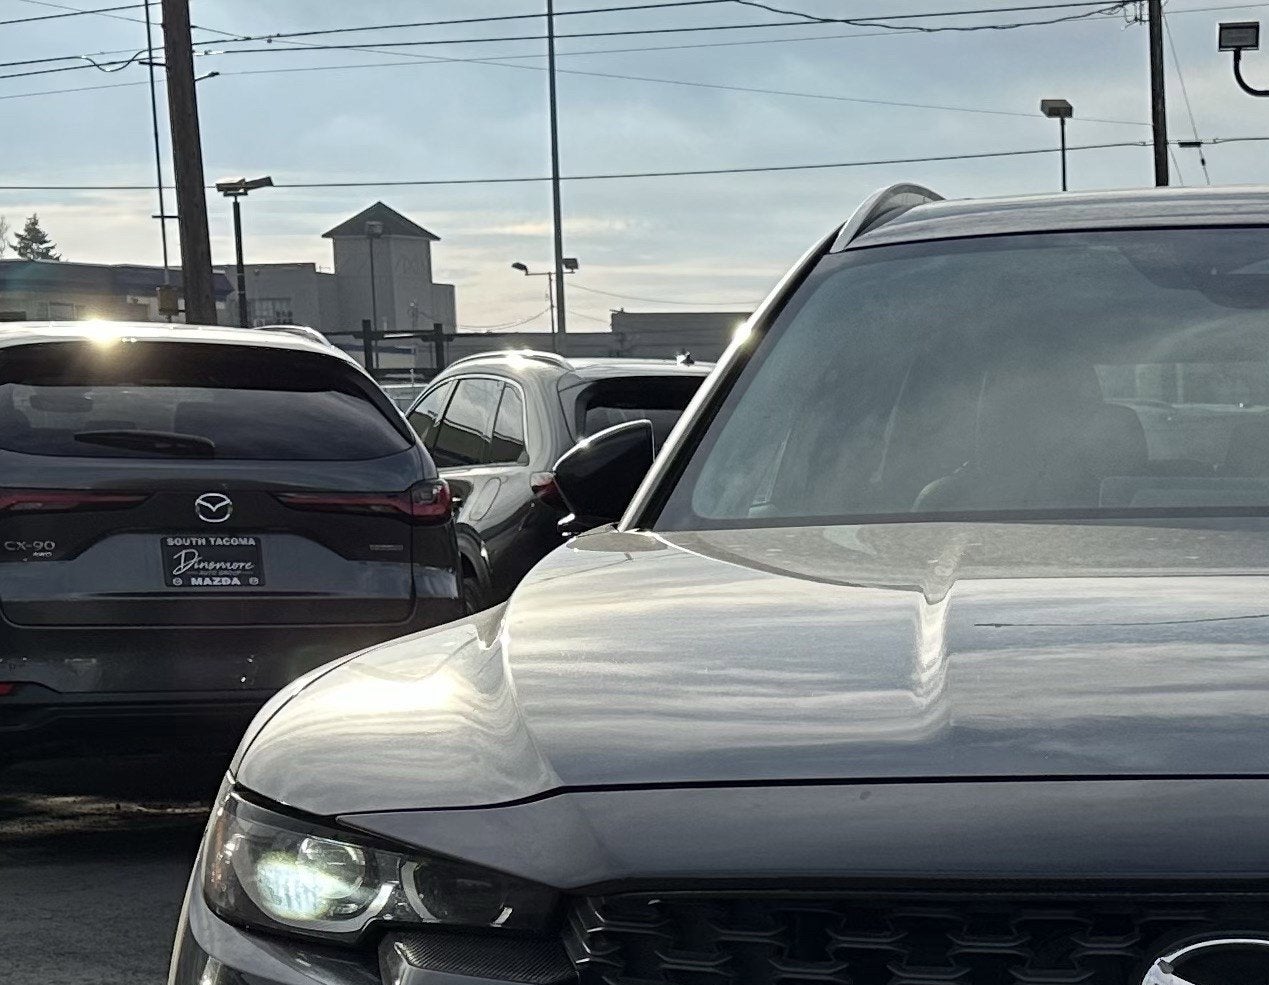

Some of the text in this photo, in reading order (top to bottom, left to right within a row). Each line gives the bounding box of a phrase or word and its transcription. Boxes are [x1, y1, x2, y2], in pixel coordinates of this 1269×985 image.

[4, 540, 56, 551] CX-90
[166, 537, 256, 546] SOUTH TACOMA
[190, 576, 241, 586] MAZDA
